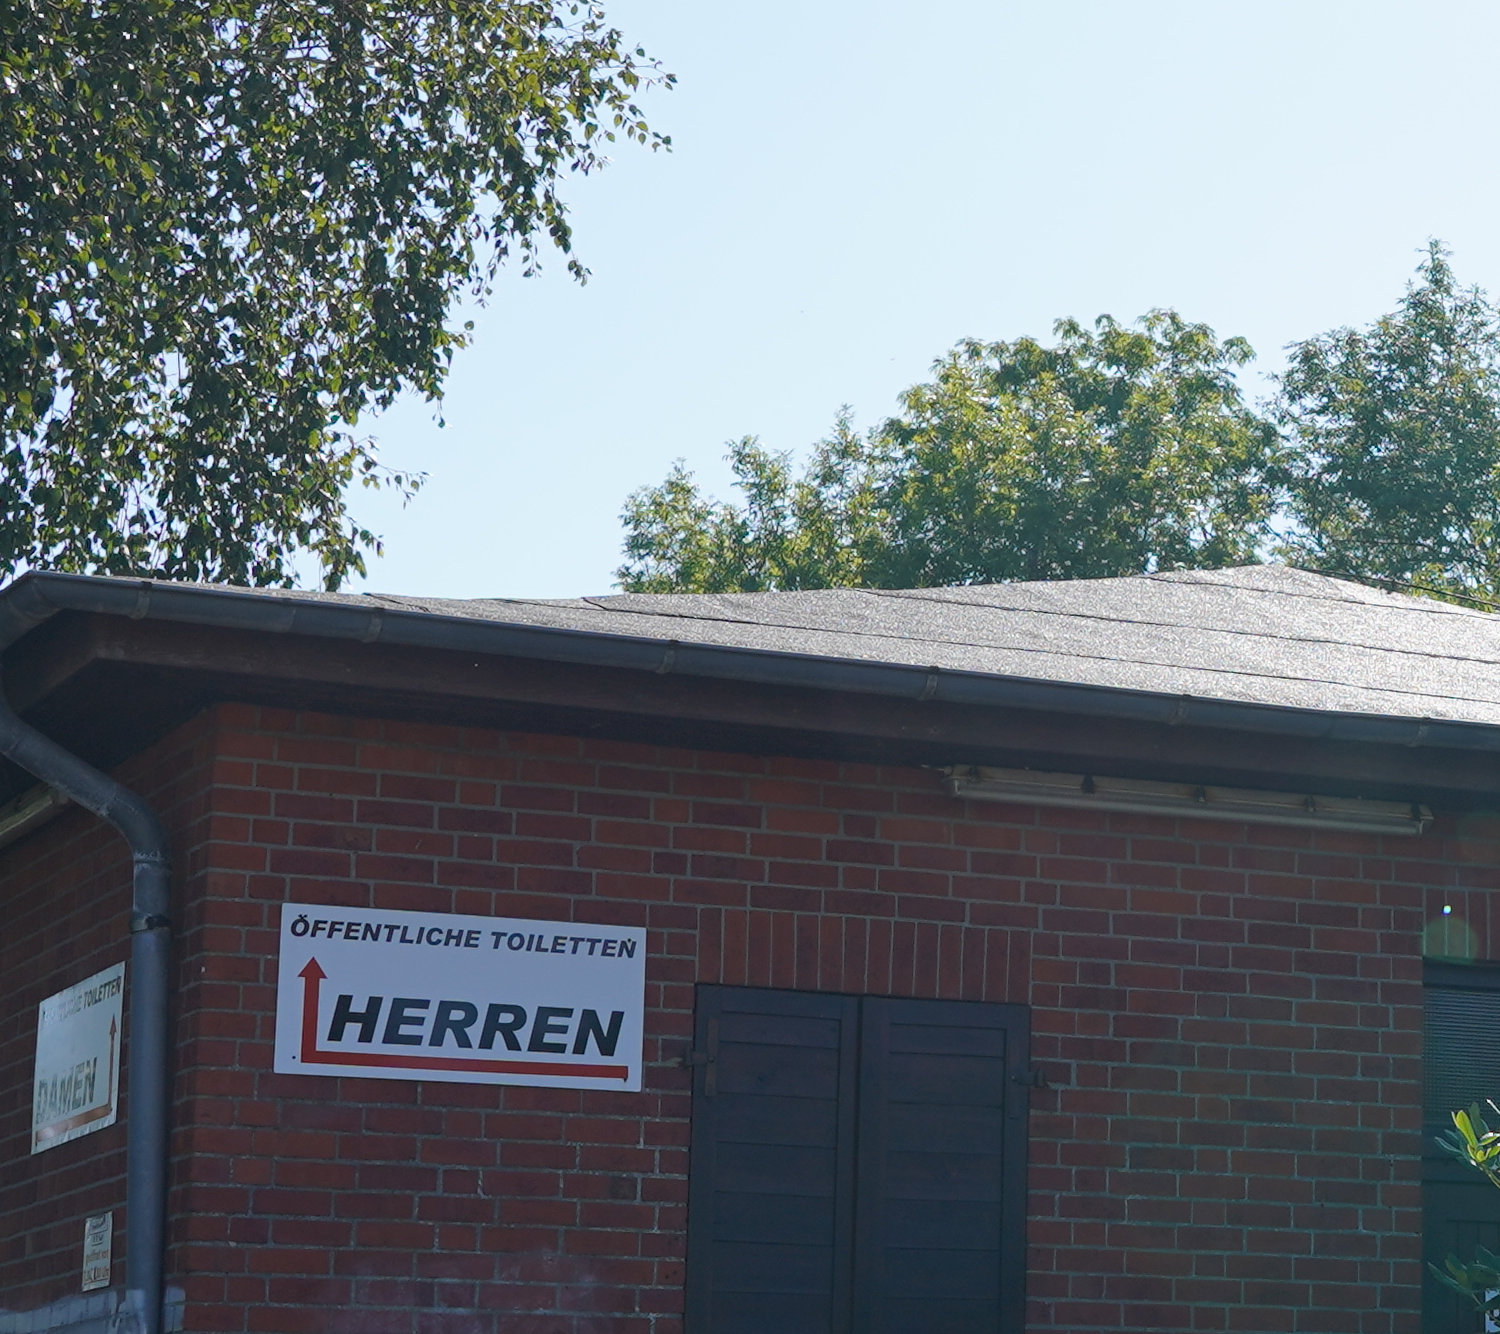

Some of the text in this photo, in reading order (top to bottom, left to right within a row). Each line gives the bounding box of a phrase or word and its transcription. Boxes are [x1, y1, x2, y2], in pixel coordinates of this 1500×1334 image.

[290, 914, 637, 959] ÖFFENTLICHE TOILETTEN
[327, 994, 625, 1057] HERREN
[35, 1056, 97, 1125] DAMEN
